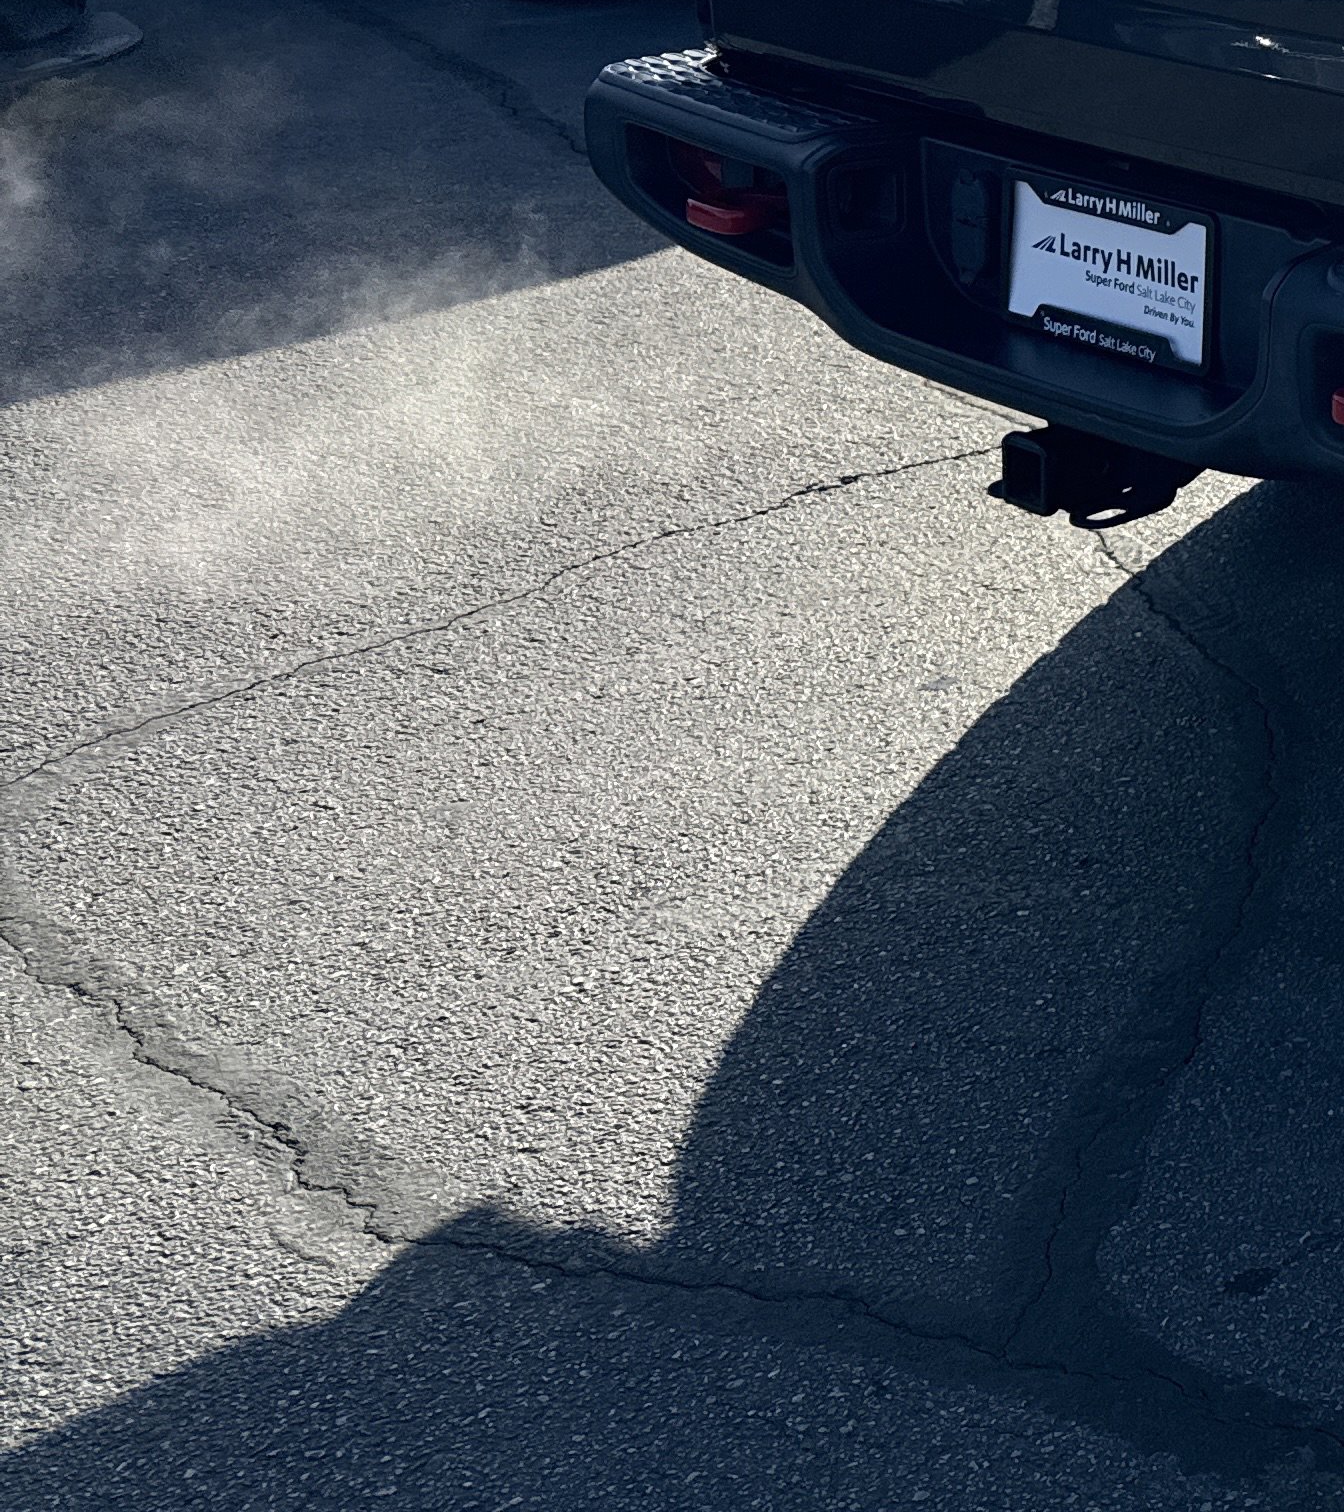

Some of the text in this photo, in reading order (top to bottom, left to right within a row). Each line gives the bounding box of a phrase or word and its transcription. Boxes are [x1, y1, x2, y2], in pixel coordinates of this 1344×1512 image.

[1068, 188, 1160, 225] Larry H Miller
[1060, 232, 1199, 293] Larry H Miller
[1085, 270, 1197, 315] Super Ford Salt Lake City
[1143, 305, 1168, 320] Driven
[1170, 312, 1180, 326] By
[1043, 316, 1157, 364] Super Ford Salt Lake City
